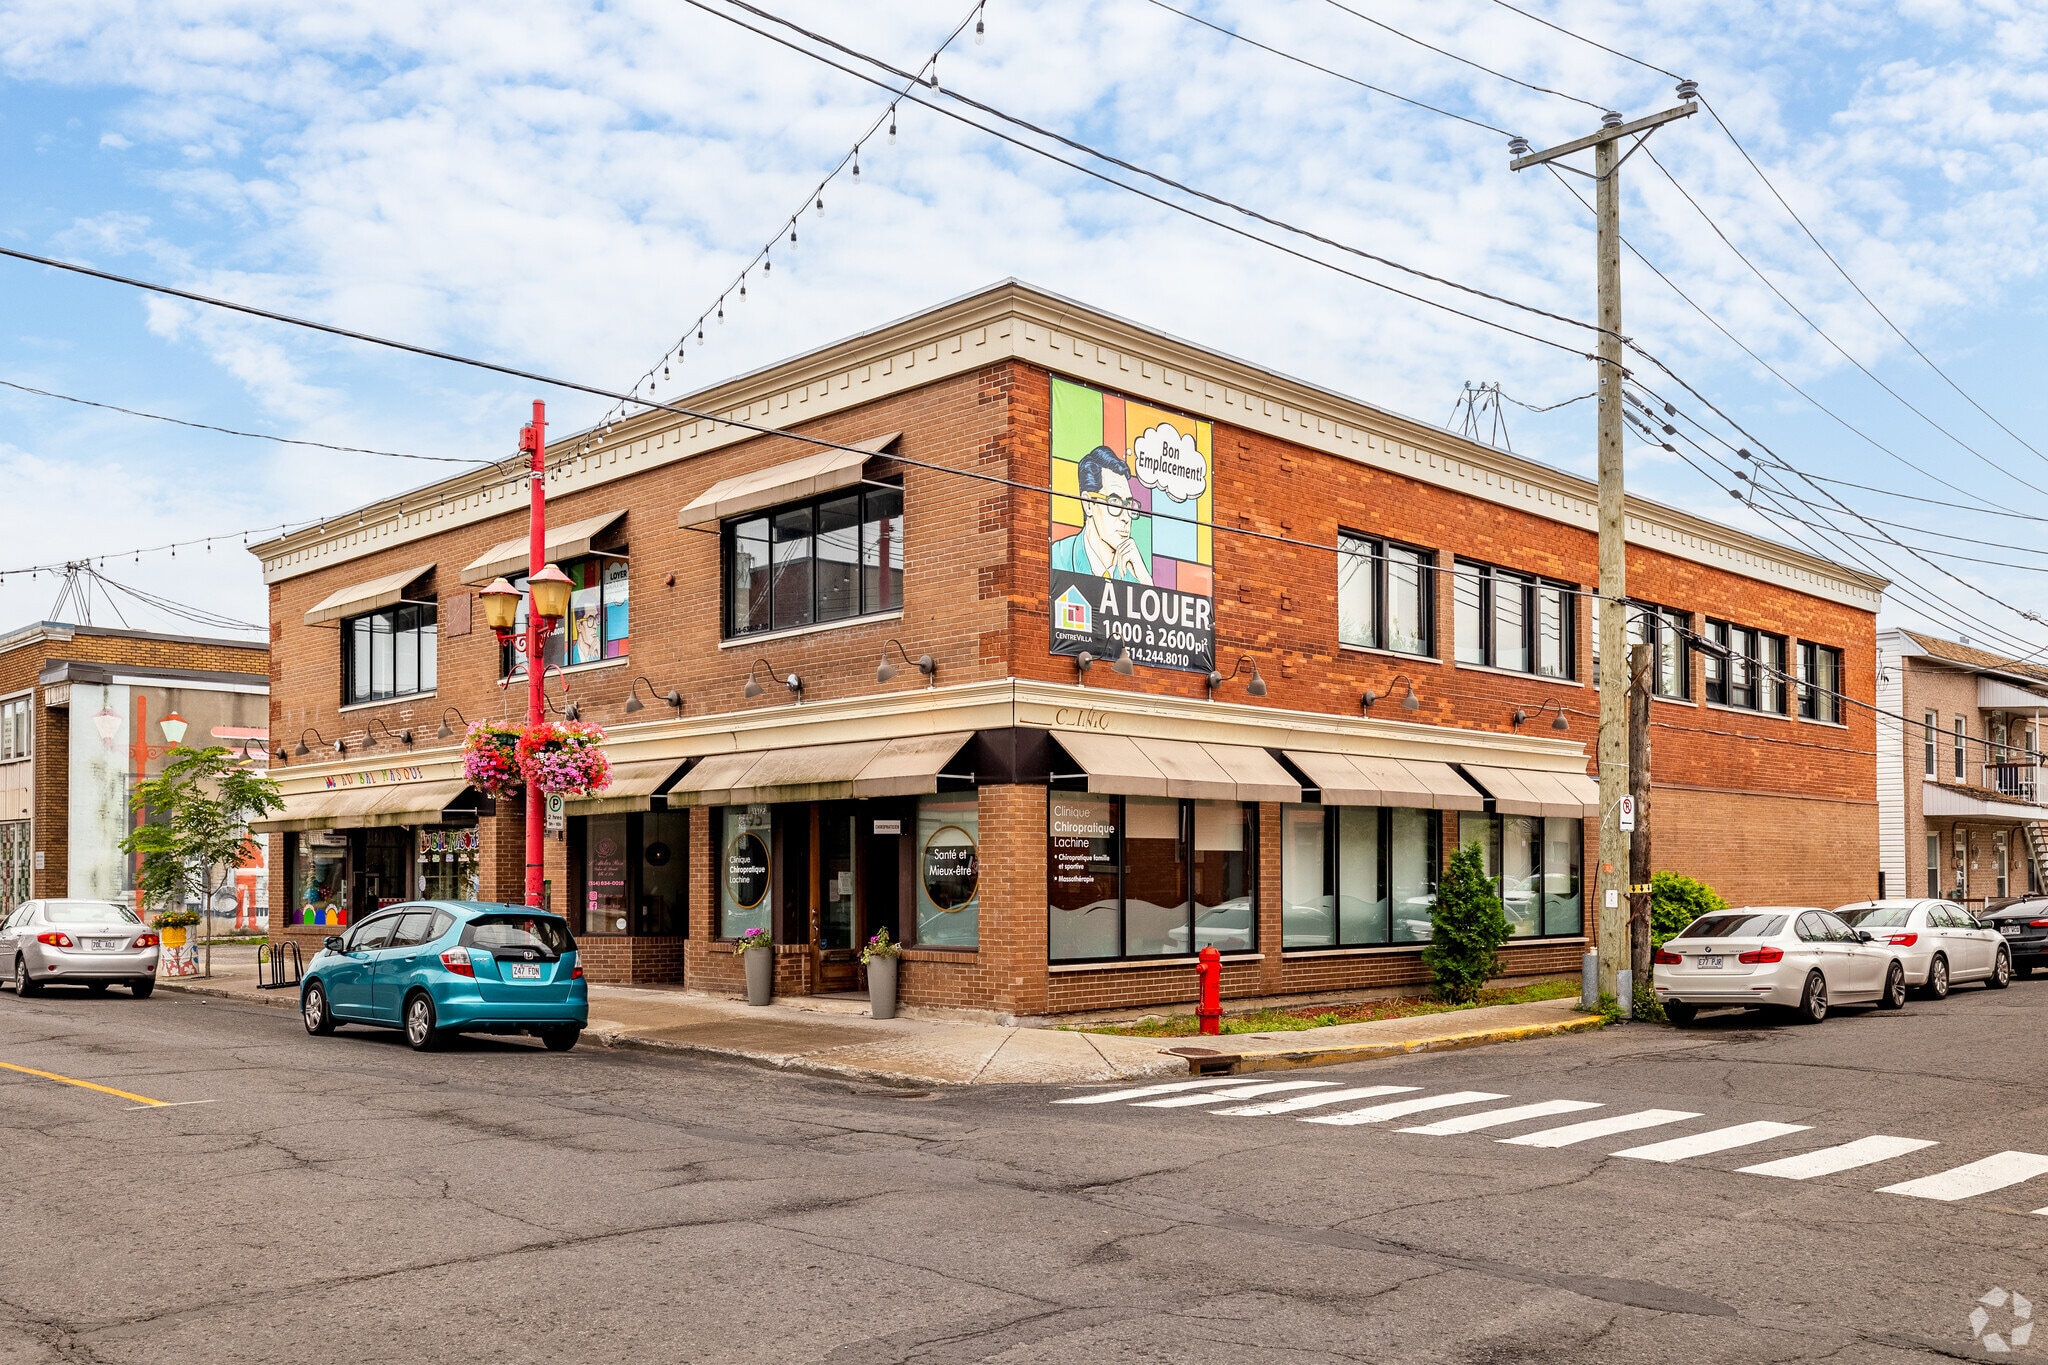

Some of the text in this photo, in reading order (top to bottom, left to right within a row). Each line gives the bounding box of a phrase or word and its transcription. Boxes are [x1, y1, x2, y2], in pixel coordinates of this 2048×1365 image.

[1139, 441, 1203, 482] Bon Emplacement!
[610, 570, 628, 580] LOYER
[1100, 579, 1211, 631] À LOUER
[1103, 619, 1143, 644] 1000
[1145, 624, 1155, 646] à
[342, 772, 354, 786] AU
[359, 770, 376, 785] BAL
[1054, 805, 1091, 819] Clinique
[1054, 821, 1115, 836] Chiropratique
[1054, 836, 1090, 848] Lachine
[729, 855, 751, 865] Clinique
[934, 848, 967, 860] Santé et
[1058, 853, 1092, 862] Chiropratique
[729, 865, 766, 875] Chiropratique
[929, 864, 972, 876] Mieux-être
[1064, 862, 1085, 871] sportive
[729, 875, 751, 884] Lachine
[1698, 958, 1709, 966] E77
[513, 966, 525, 975] Z47
